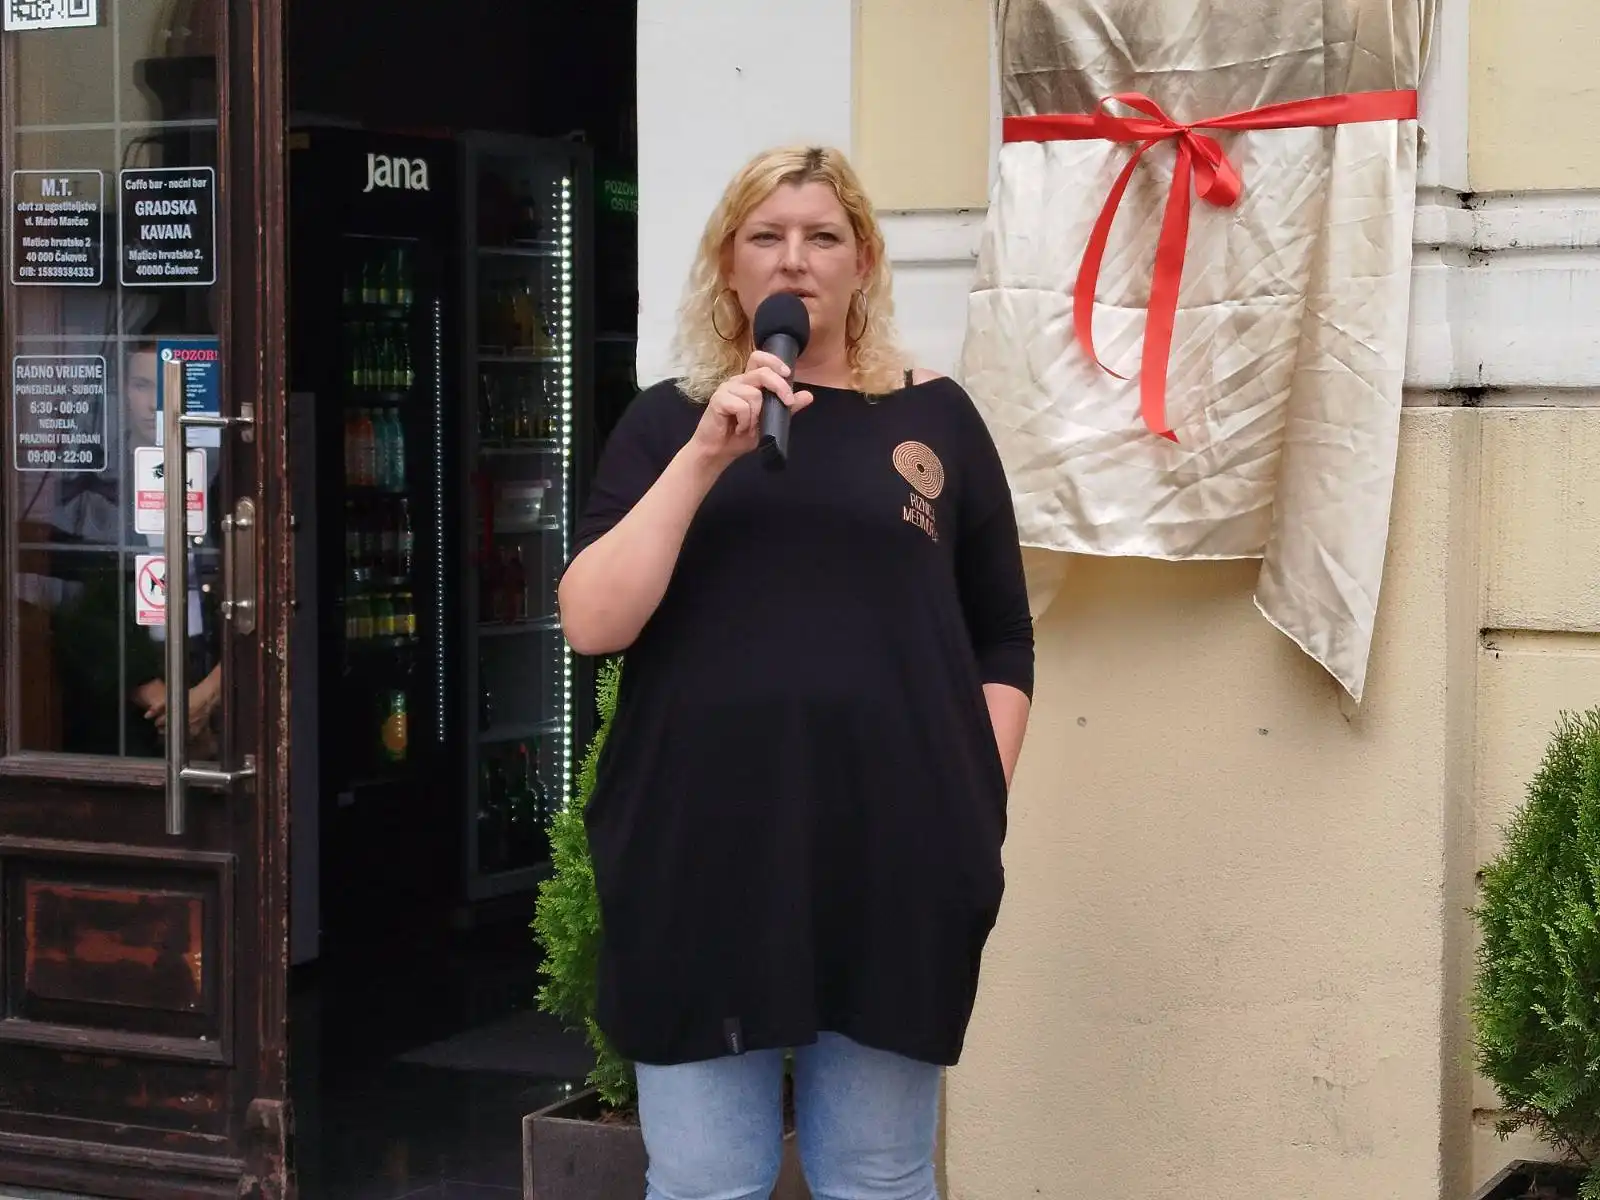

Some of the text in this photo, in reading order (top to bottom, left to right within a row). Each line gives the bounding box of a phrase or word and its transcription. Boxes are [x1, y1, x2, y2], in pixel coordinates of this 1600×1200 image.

[362, 153, 430, 192] Jana
[41, 178, 72, 197] M.T.
[125, 179, 148, 190] Caffe
[148, 179, 163, 190] bar
[168, 177, 191, 189] noćni
[191, 178, 207, 188] bar
[17, 201, 97, 213] obrt za ugostiteljstvo
[134, 200, 198, 216] GRADSKA
[35, 216, 58, 226] Mario
[59, 215, 89, 226] Marčec
[140, 224, 192, 240] KAVANA
[22, 237, 91, 247] Matice hrvatske 2
[26, 249, 88, 262] 40 000 Čakovec
[128, 248, 204, 261] Matice hrvatske 2,
[19, 266, 94, 278] OIB: 15839384333
[135, 262, 199, 276] 40000 Čakovec
[172, 349, 218, 361] POZOR!
[16, 365, 102, 379] RADNO VRIJEME
[15, 384, 67, 395] PONEDJELJAK
[71, 384, 103, 395] SUBOTA
[30, 401, 53, 414] 6:30
[59, 401, 90, 414] 00:00
[19, 433, 55, 444] PRAZNICI
[61, 433, 101, 444] BLAGDANI
[27, 450, 57, 463] 09:00
[63, 450, 93, 463] 22:00
